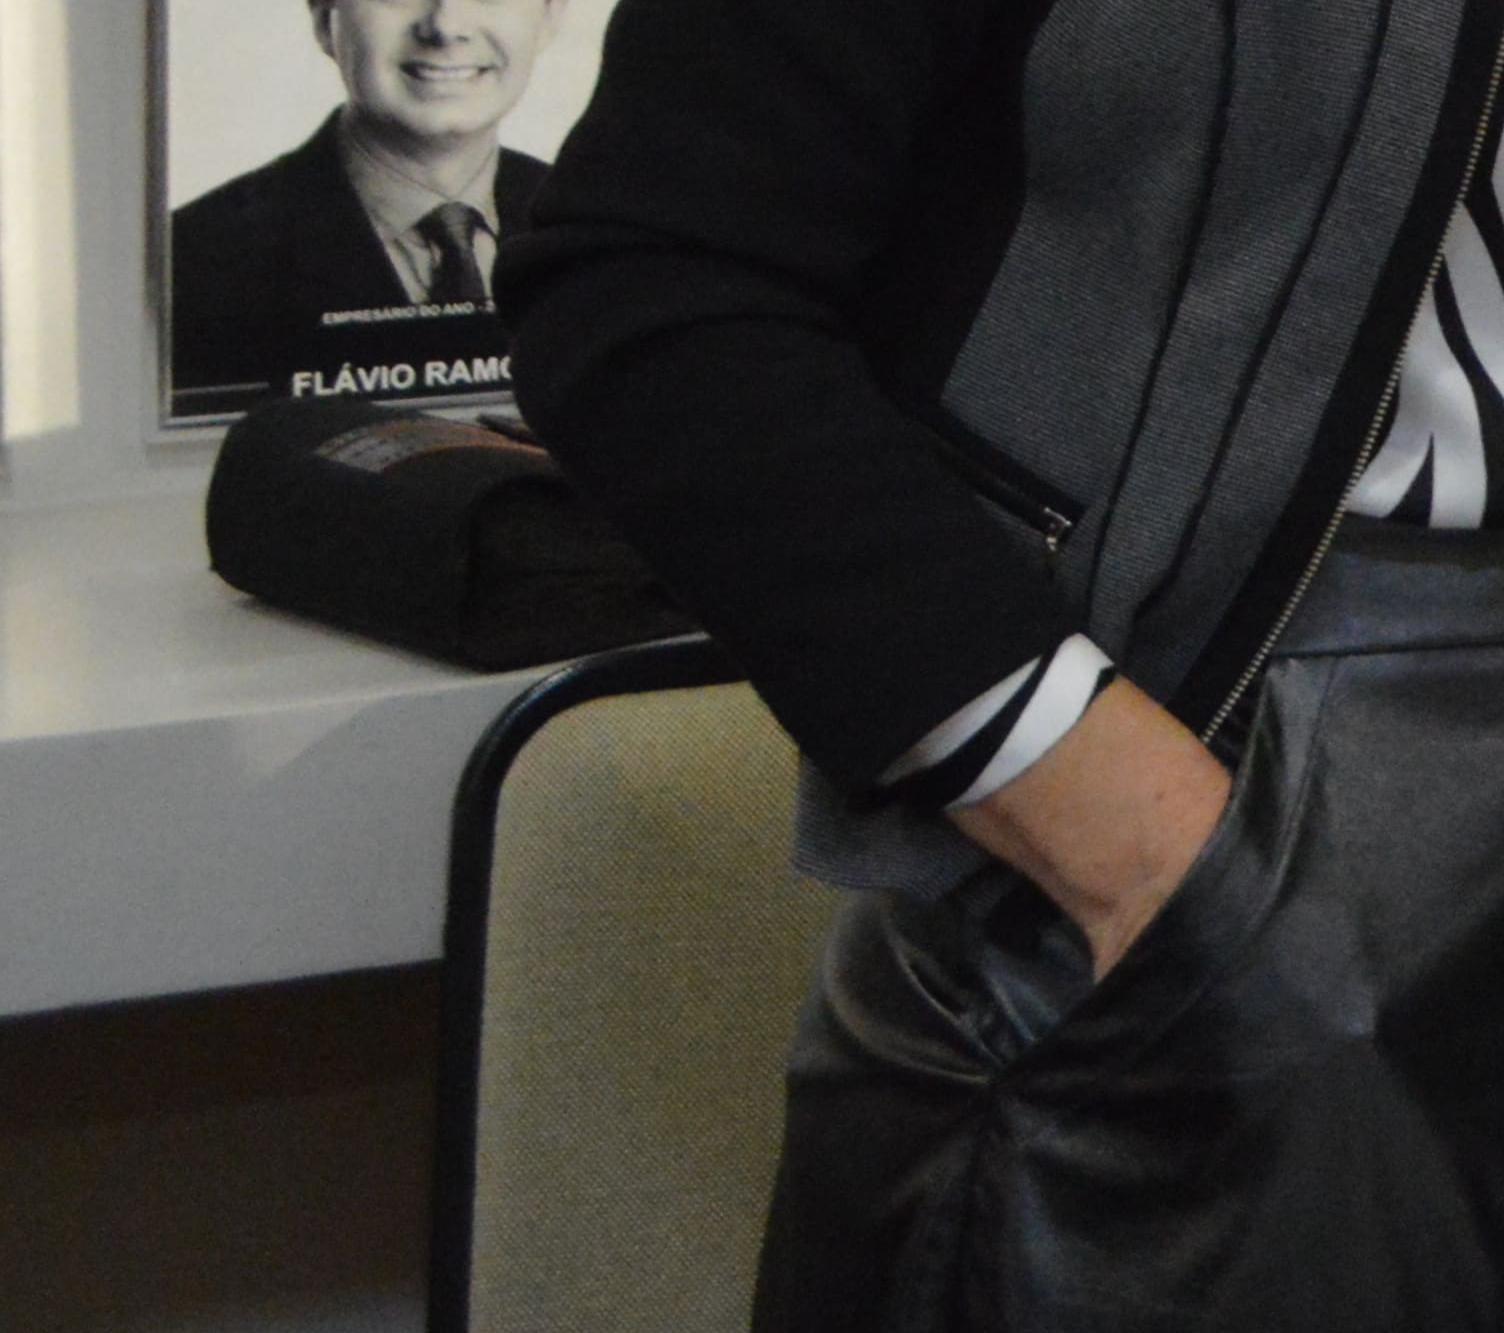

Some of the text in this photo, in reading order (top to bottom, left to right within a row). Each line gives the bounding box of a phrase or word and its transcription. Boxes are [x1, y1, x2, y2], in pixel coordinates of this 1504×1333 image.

[322, 306, 417, 325] EMPRESÁRIO
[420, 304, 441, 317] DO
[443, 301, 475, 315] ANO
[291, 362, 416, 398] FLÁVIO
